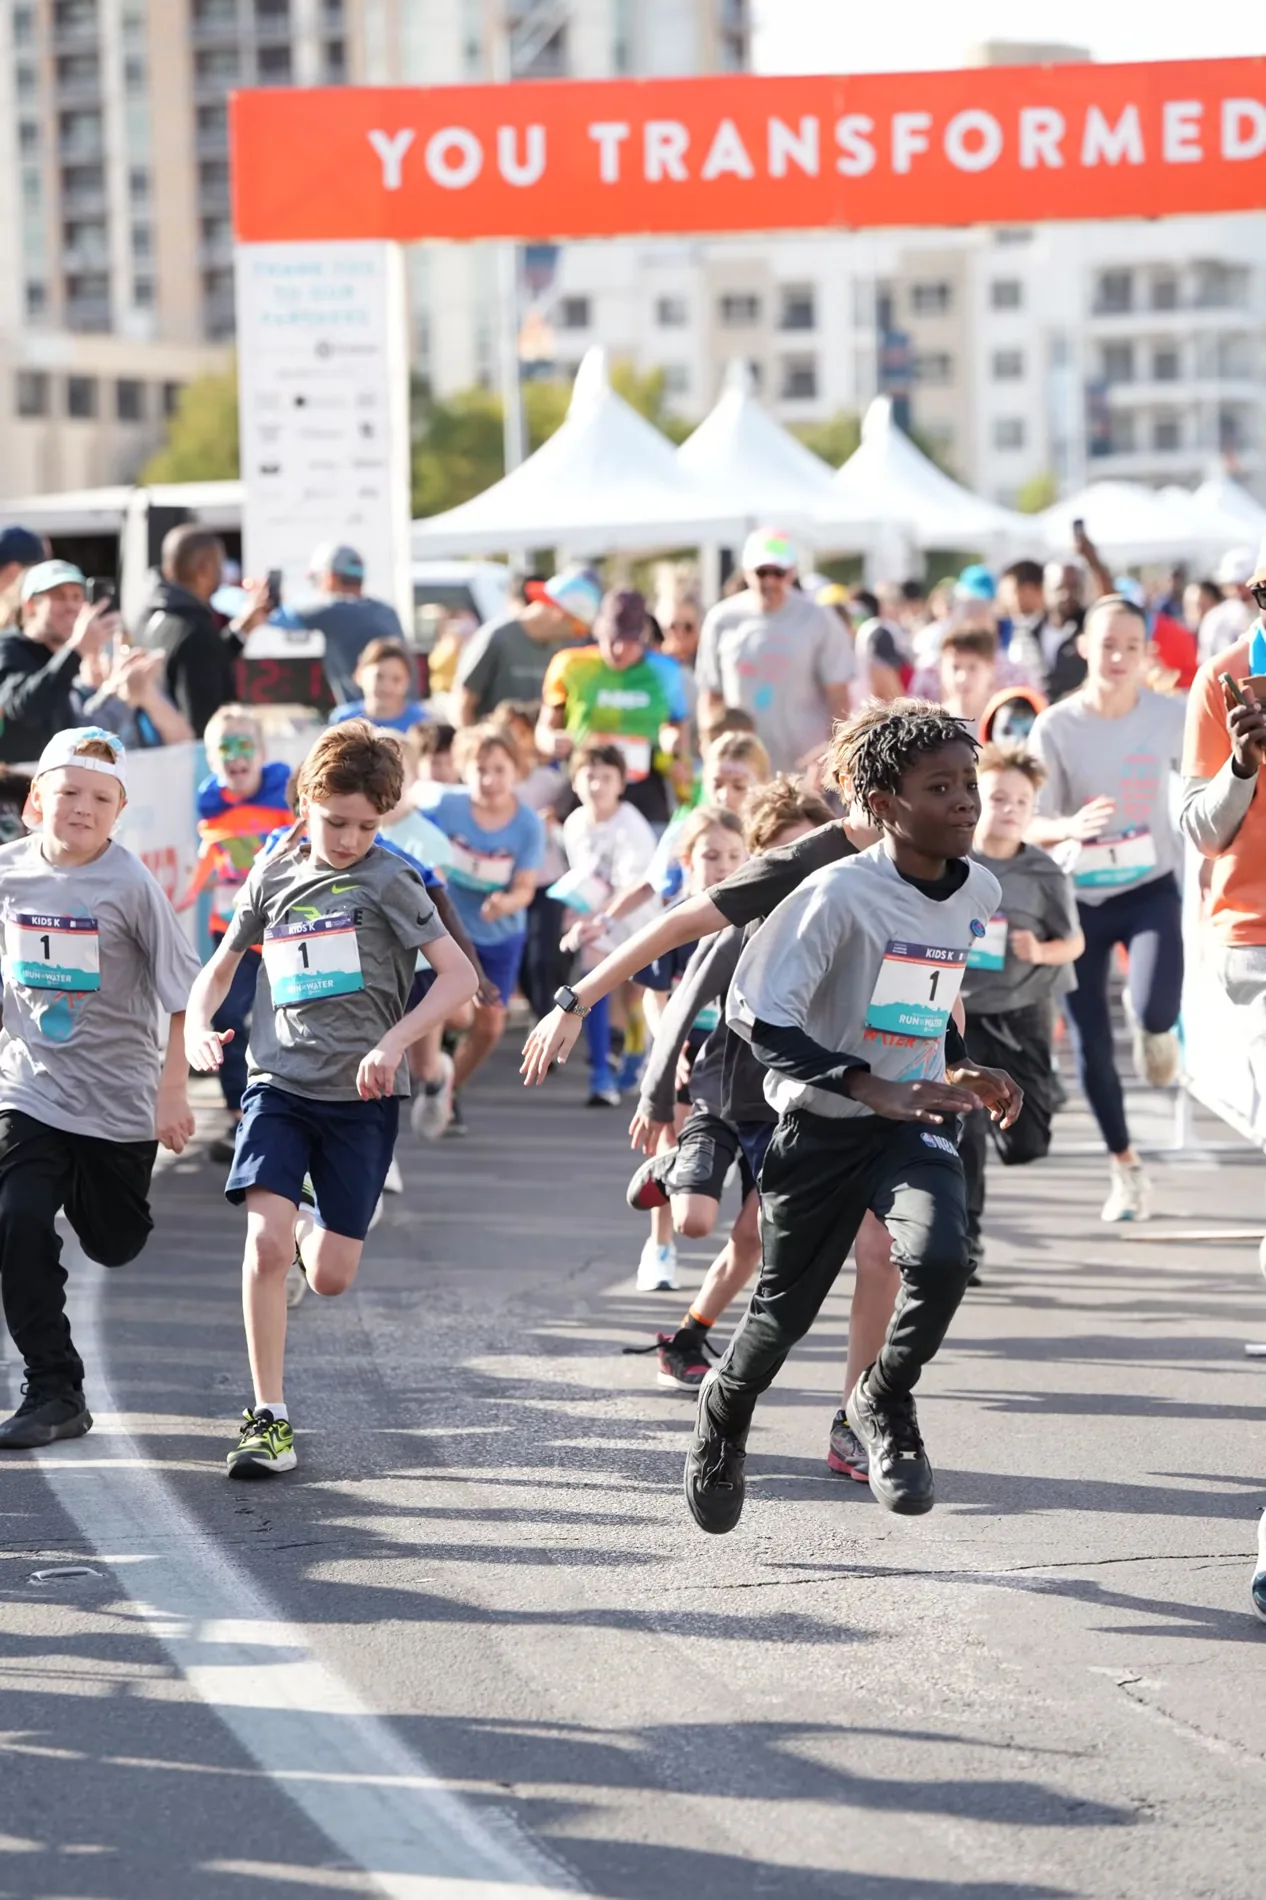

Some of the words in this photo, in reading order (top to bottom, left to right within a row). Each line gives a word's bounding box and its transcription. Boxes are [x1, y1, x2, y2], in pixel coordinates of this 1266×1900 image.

[366, 124, 547, 191] YOU
[588, 97, 1266, 184] TRANSFORMED
[31, 916, 52, 927] KIDS
[53, 918, 60, 927] K
[288, 923, 307, 935] KIDS
[309, 923, 316, 931] K
[40, 934, 50, 960] 1
[298, 942, 309, 968] 1
[925, 948, 946, 960] KIDS
[947, 951, 955, 960] K
[45, 973, 72, 983] WATER
[306, 980, 334, 990] WATER
[929, 970, 940, 1001] 1
[898, 1013, 920, 1026] RUN
